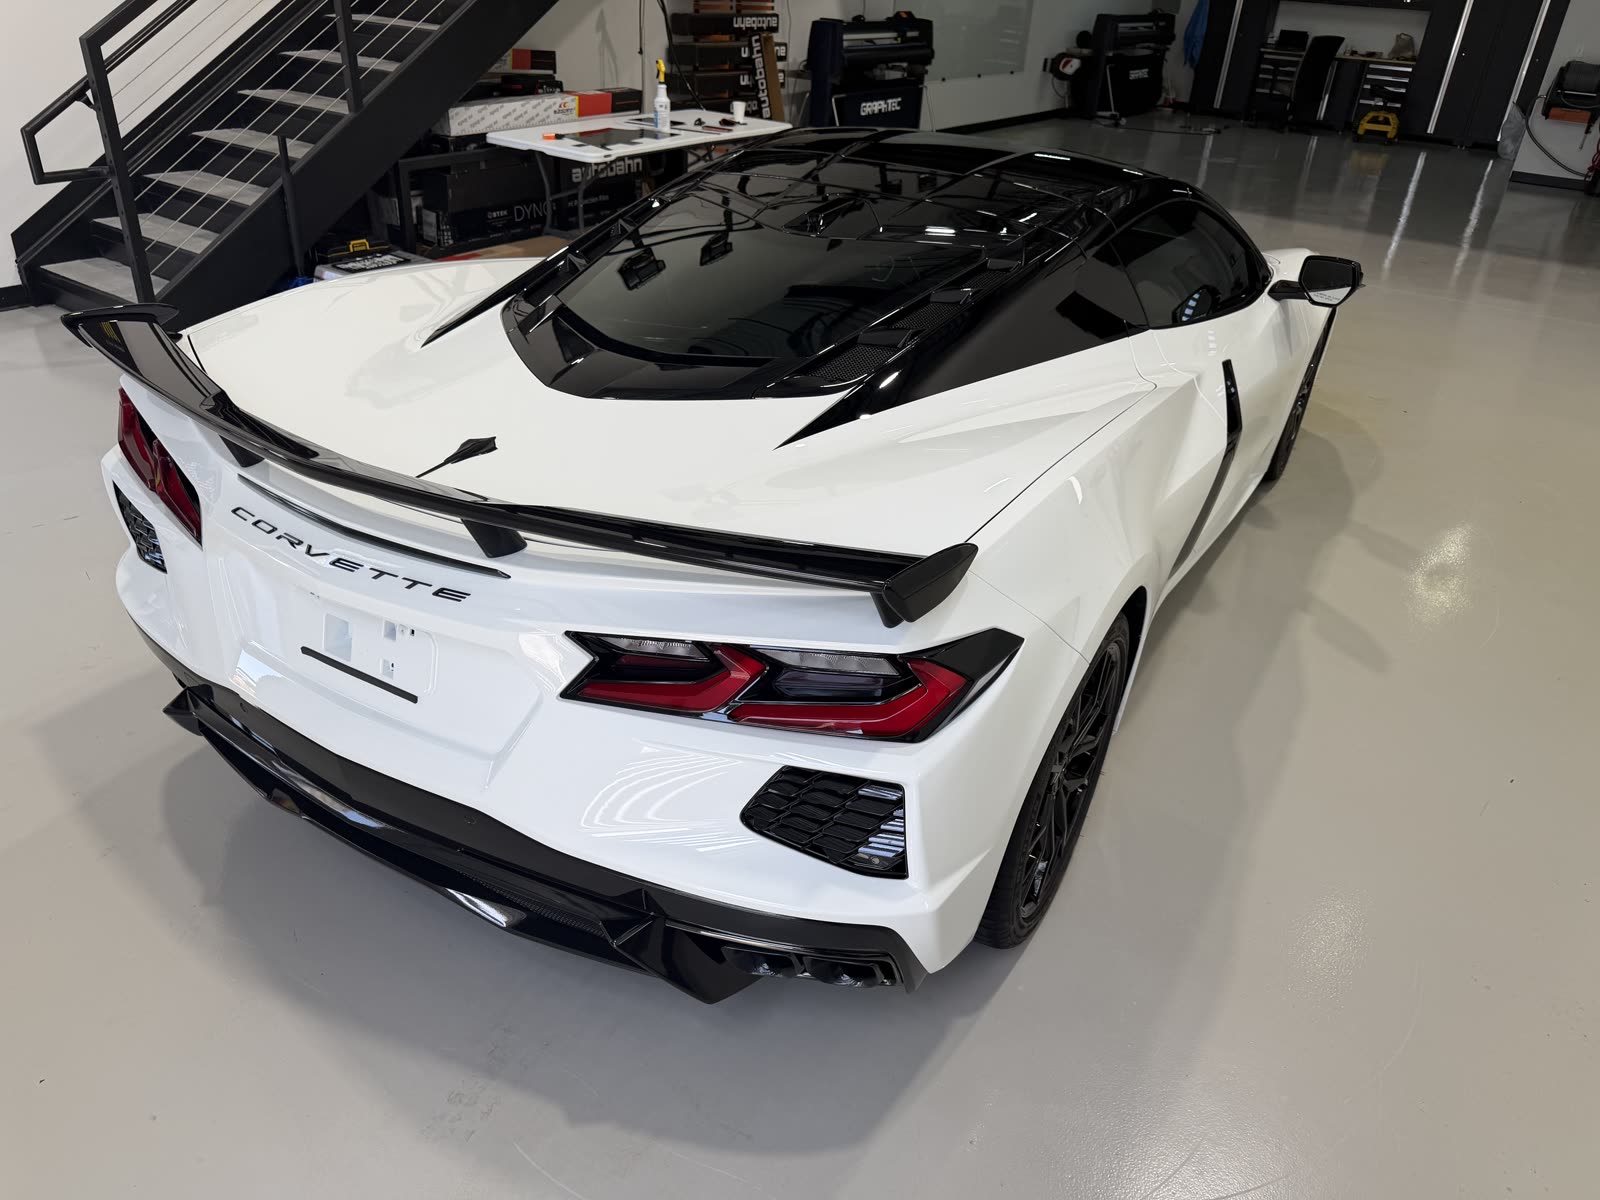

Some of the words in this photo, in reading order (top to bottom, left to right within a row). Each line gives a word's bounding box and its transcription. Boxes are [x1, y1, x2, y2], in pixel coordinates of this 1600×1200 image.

[733, 17, 778, 30] autobahn
[752, 35, 771, 119] autobahn
[860, 97, 902, 116] GRAPHTEC
[231, 506, 471, 602] CORVETTE
